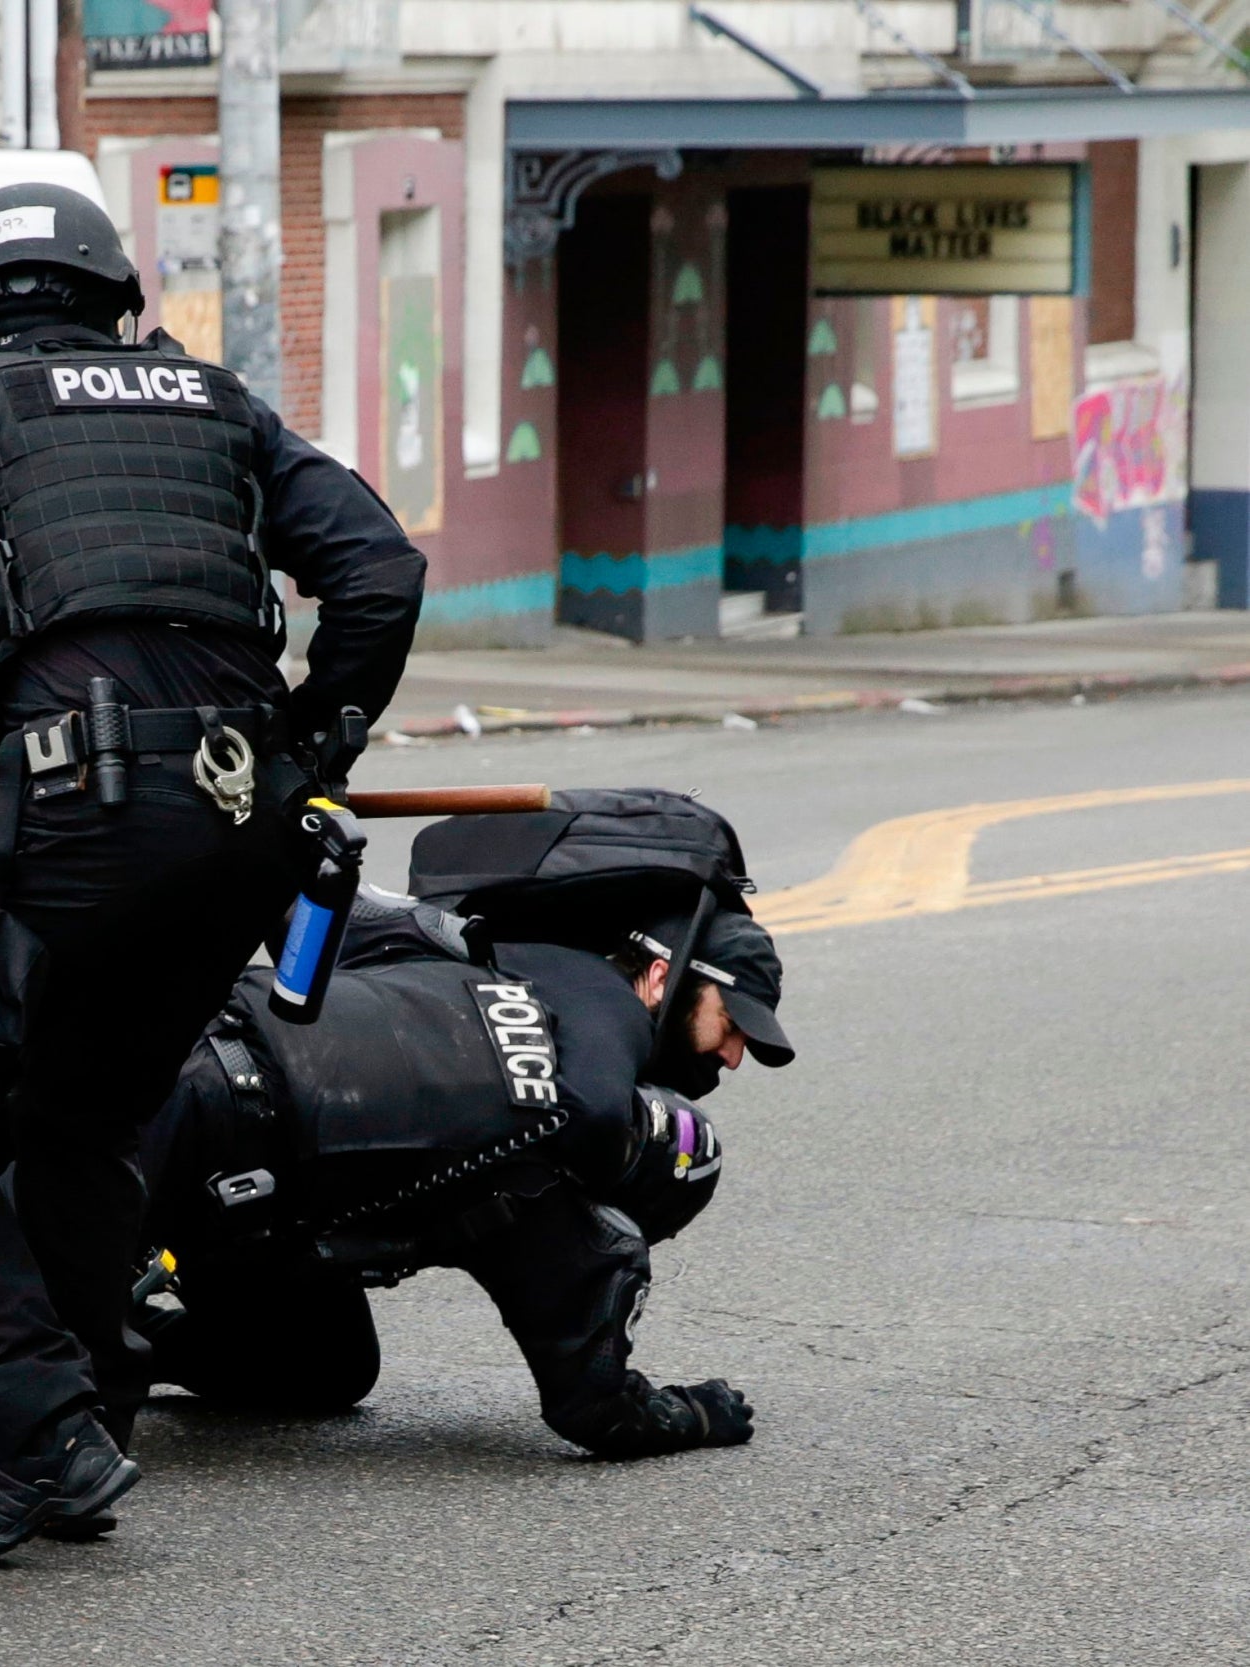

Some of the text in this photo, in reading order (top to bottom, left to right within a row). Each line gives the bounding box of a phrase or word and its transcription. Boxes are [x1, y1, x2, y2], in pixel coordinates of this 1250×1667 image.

[856, 200, 1030, 229] BLACK LIVES
[888, 229, 993, 258] MATTER
[52, 366, 208, 404] POLICE
[476, 984, 558, 1104] POLICE
